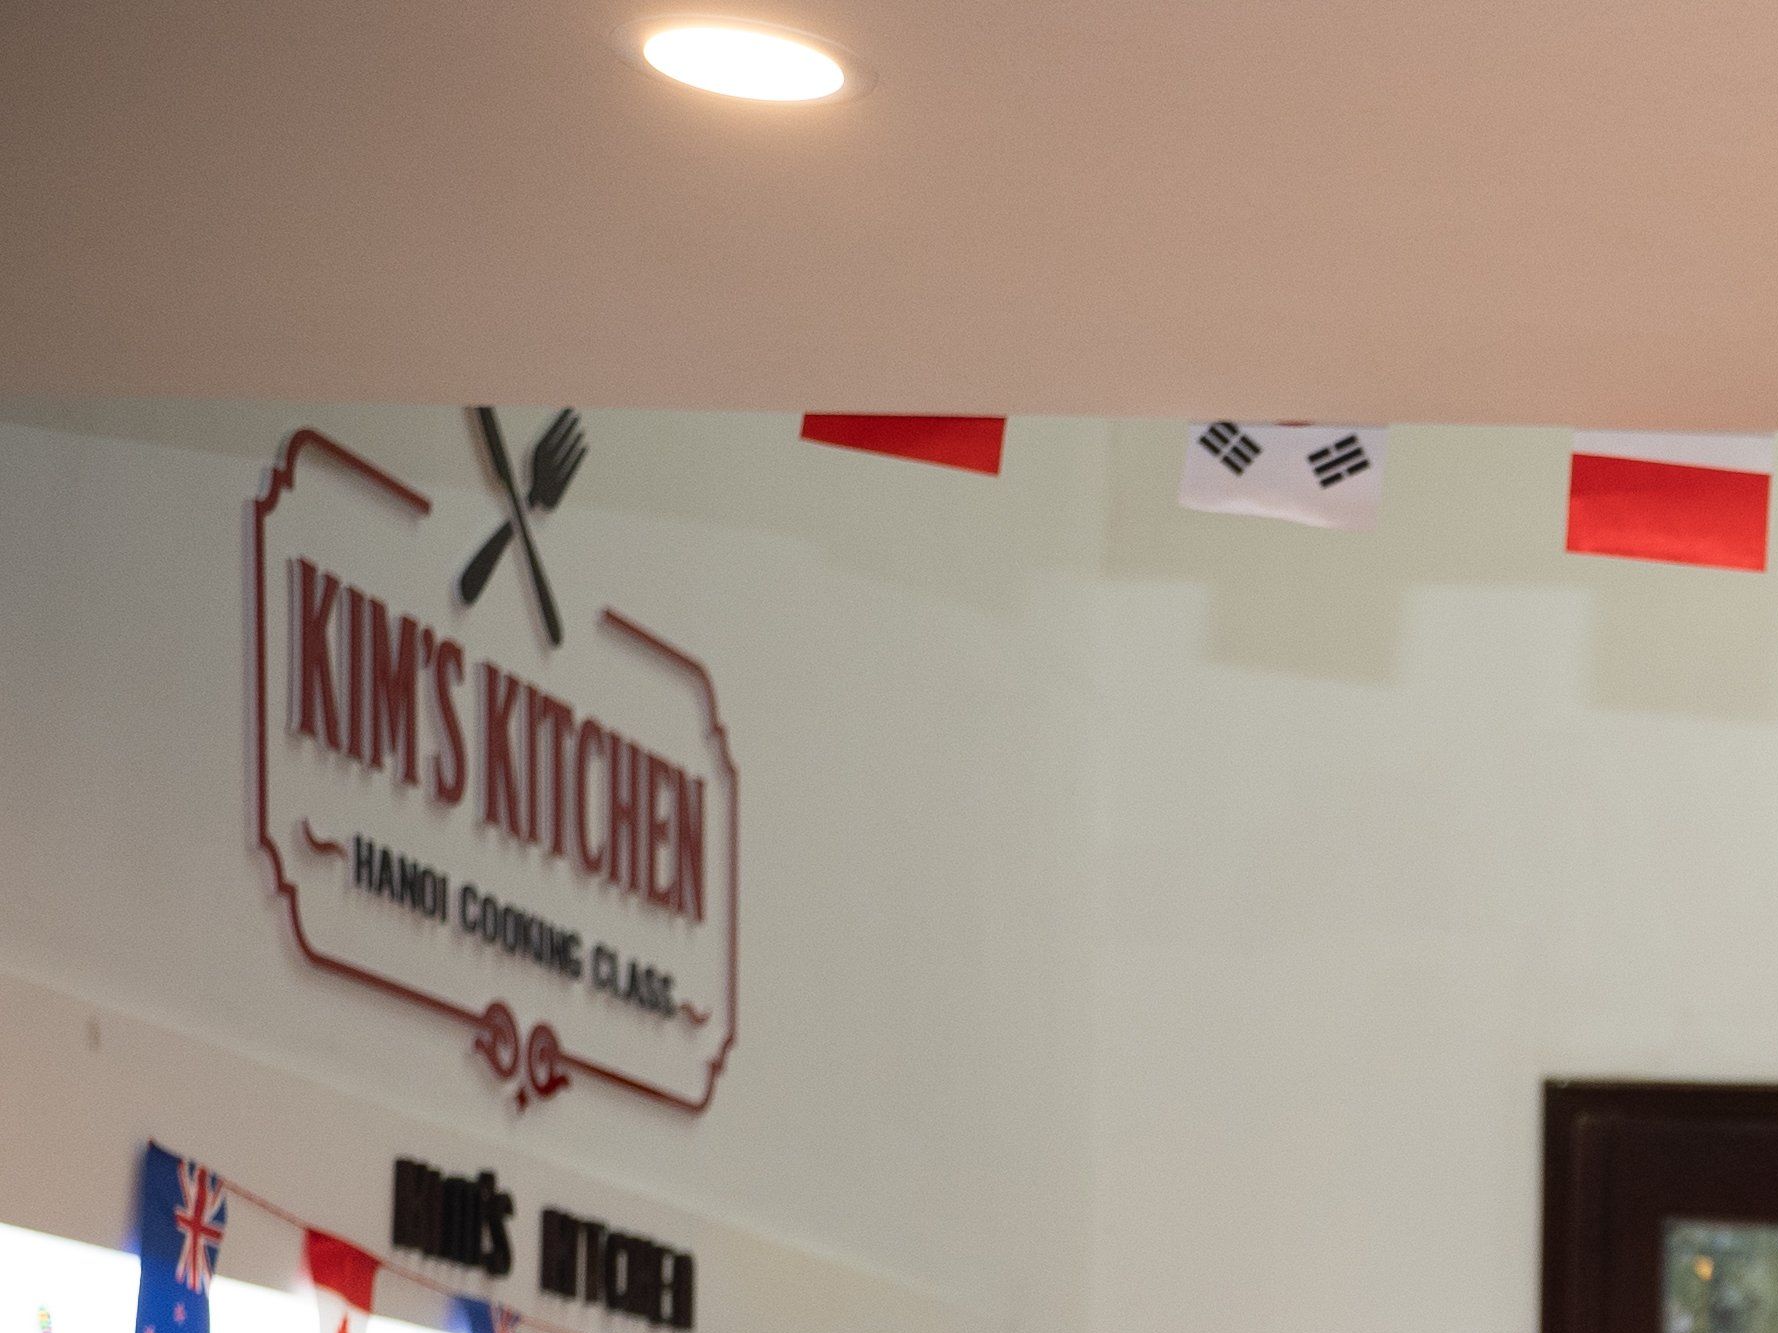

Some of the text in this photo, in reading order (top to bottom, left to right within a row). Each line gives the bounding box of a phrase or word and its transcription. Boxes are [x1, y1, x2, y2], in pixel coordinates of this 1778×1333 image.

[292, 553, 707, 927] KIM'S KITCHEN
[354, 832, 676, 1019] HANOI COOKING CLASS
